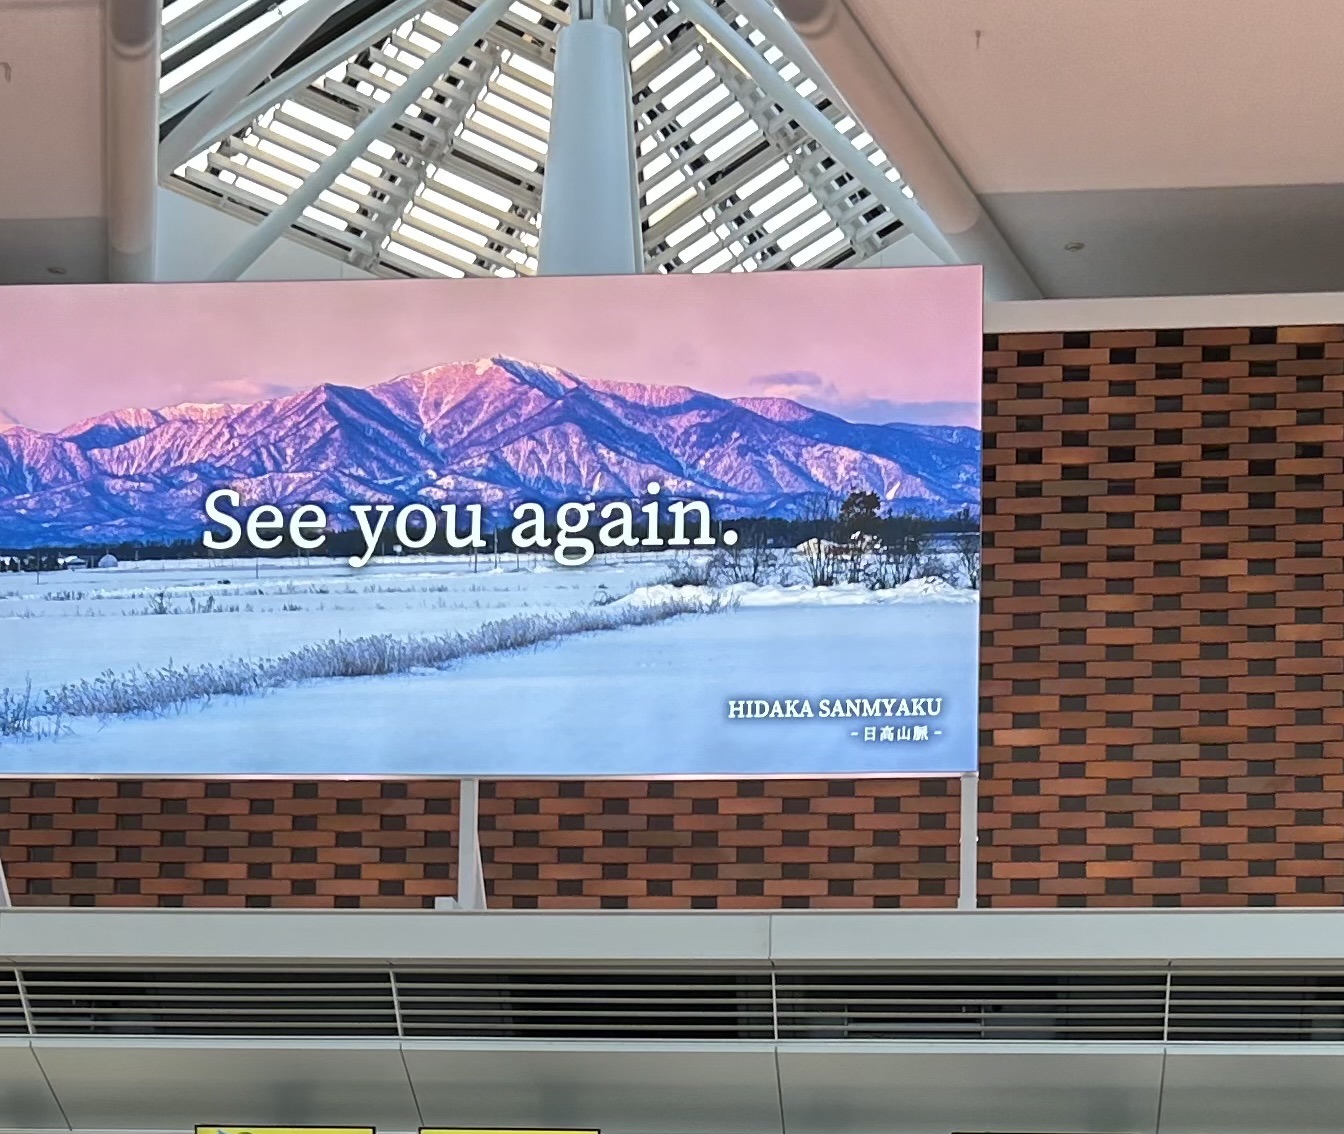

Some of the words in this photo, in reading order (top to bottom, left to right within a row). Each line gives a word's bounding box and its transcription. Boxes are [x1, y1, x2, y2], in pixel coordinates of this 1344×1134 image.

[203, 489, 327, 550] See
[349, 499, 486, 568] you
[511, 481, 739, 567] again.
[728, 699, 814, 718] HIDAKA
[818, 698, 943, 718] SANMYAKU
